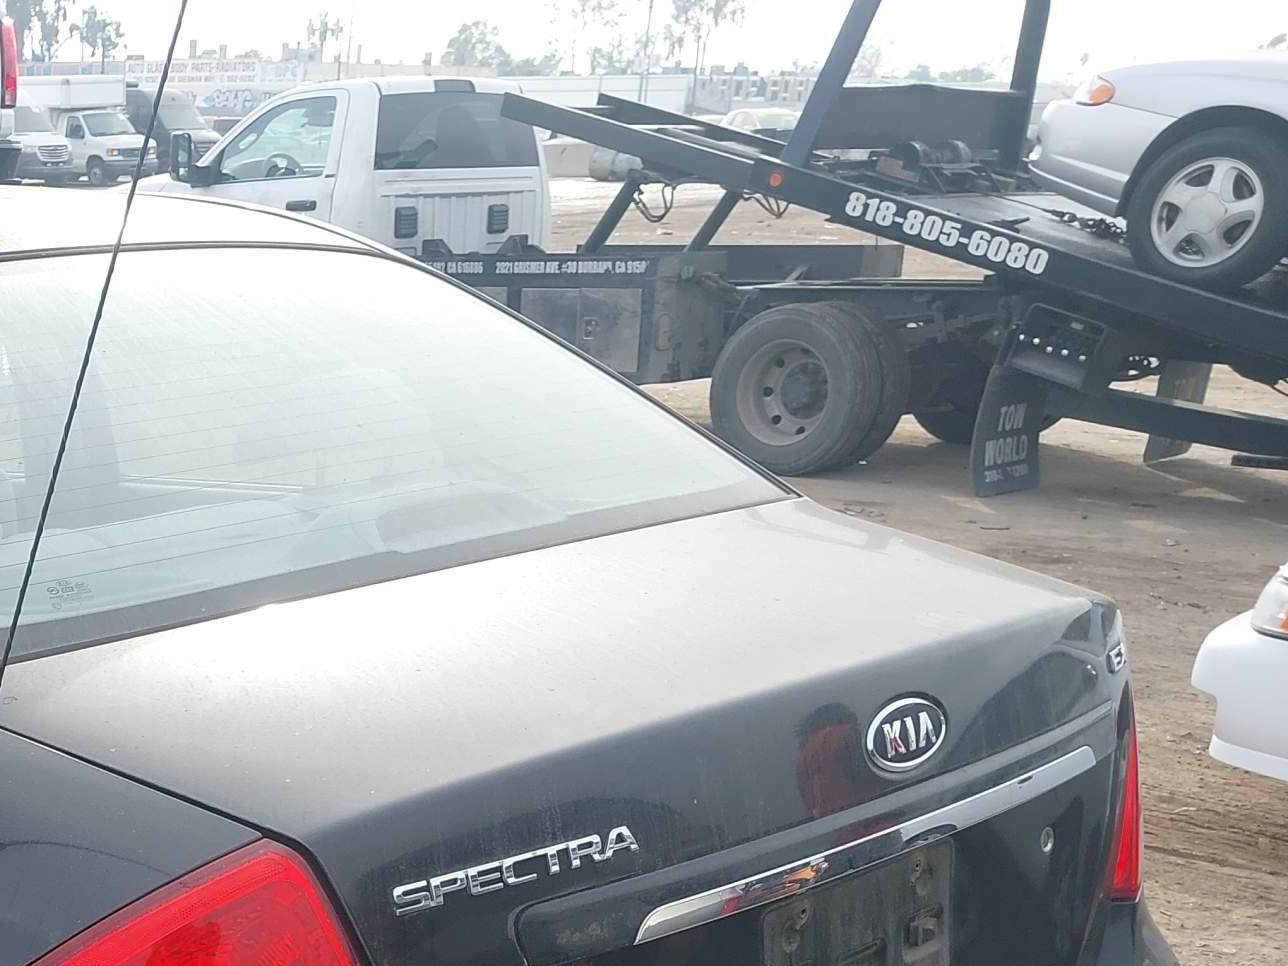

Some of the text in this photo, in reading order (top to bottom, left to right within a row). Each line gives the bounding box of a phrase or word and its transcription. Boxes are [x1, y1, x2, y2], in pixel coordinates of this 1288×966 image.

[845, 191, 1049, 275] 818-805-6080
[998, 403, 1027, 431] TOW
[984, 433, 1028, 467] WORLD
[881, 710, 936, 759] KIA
[392, 825, 641, 917] SPECTRA
